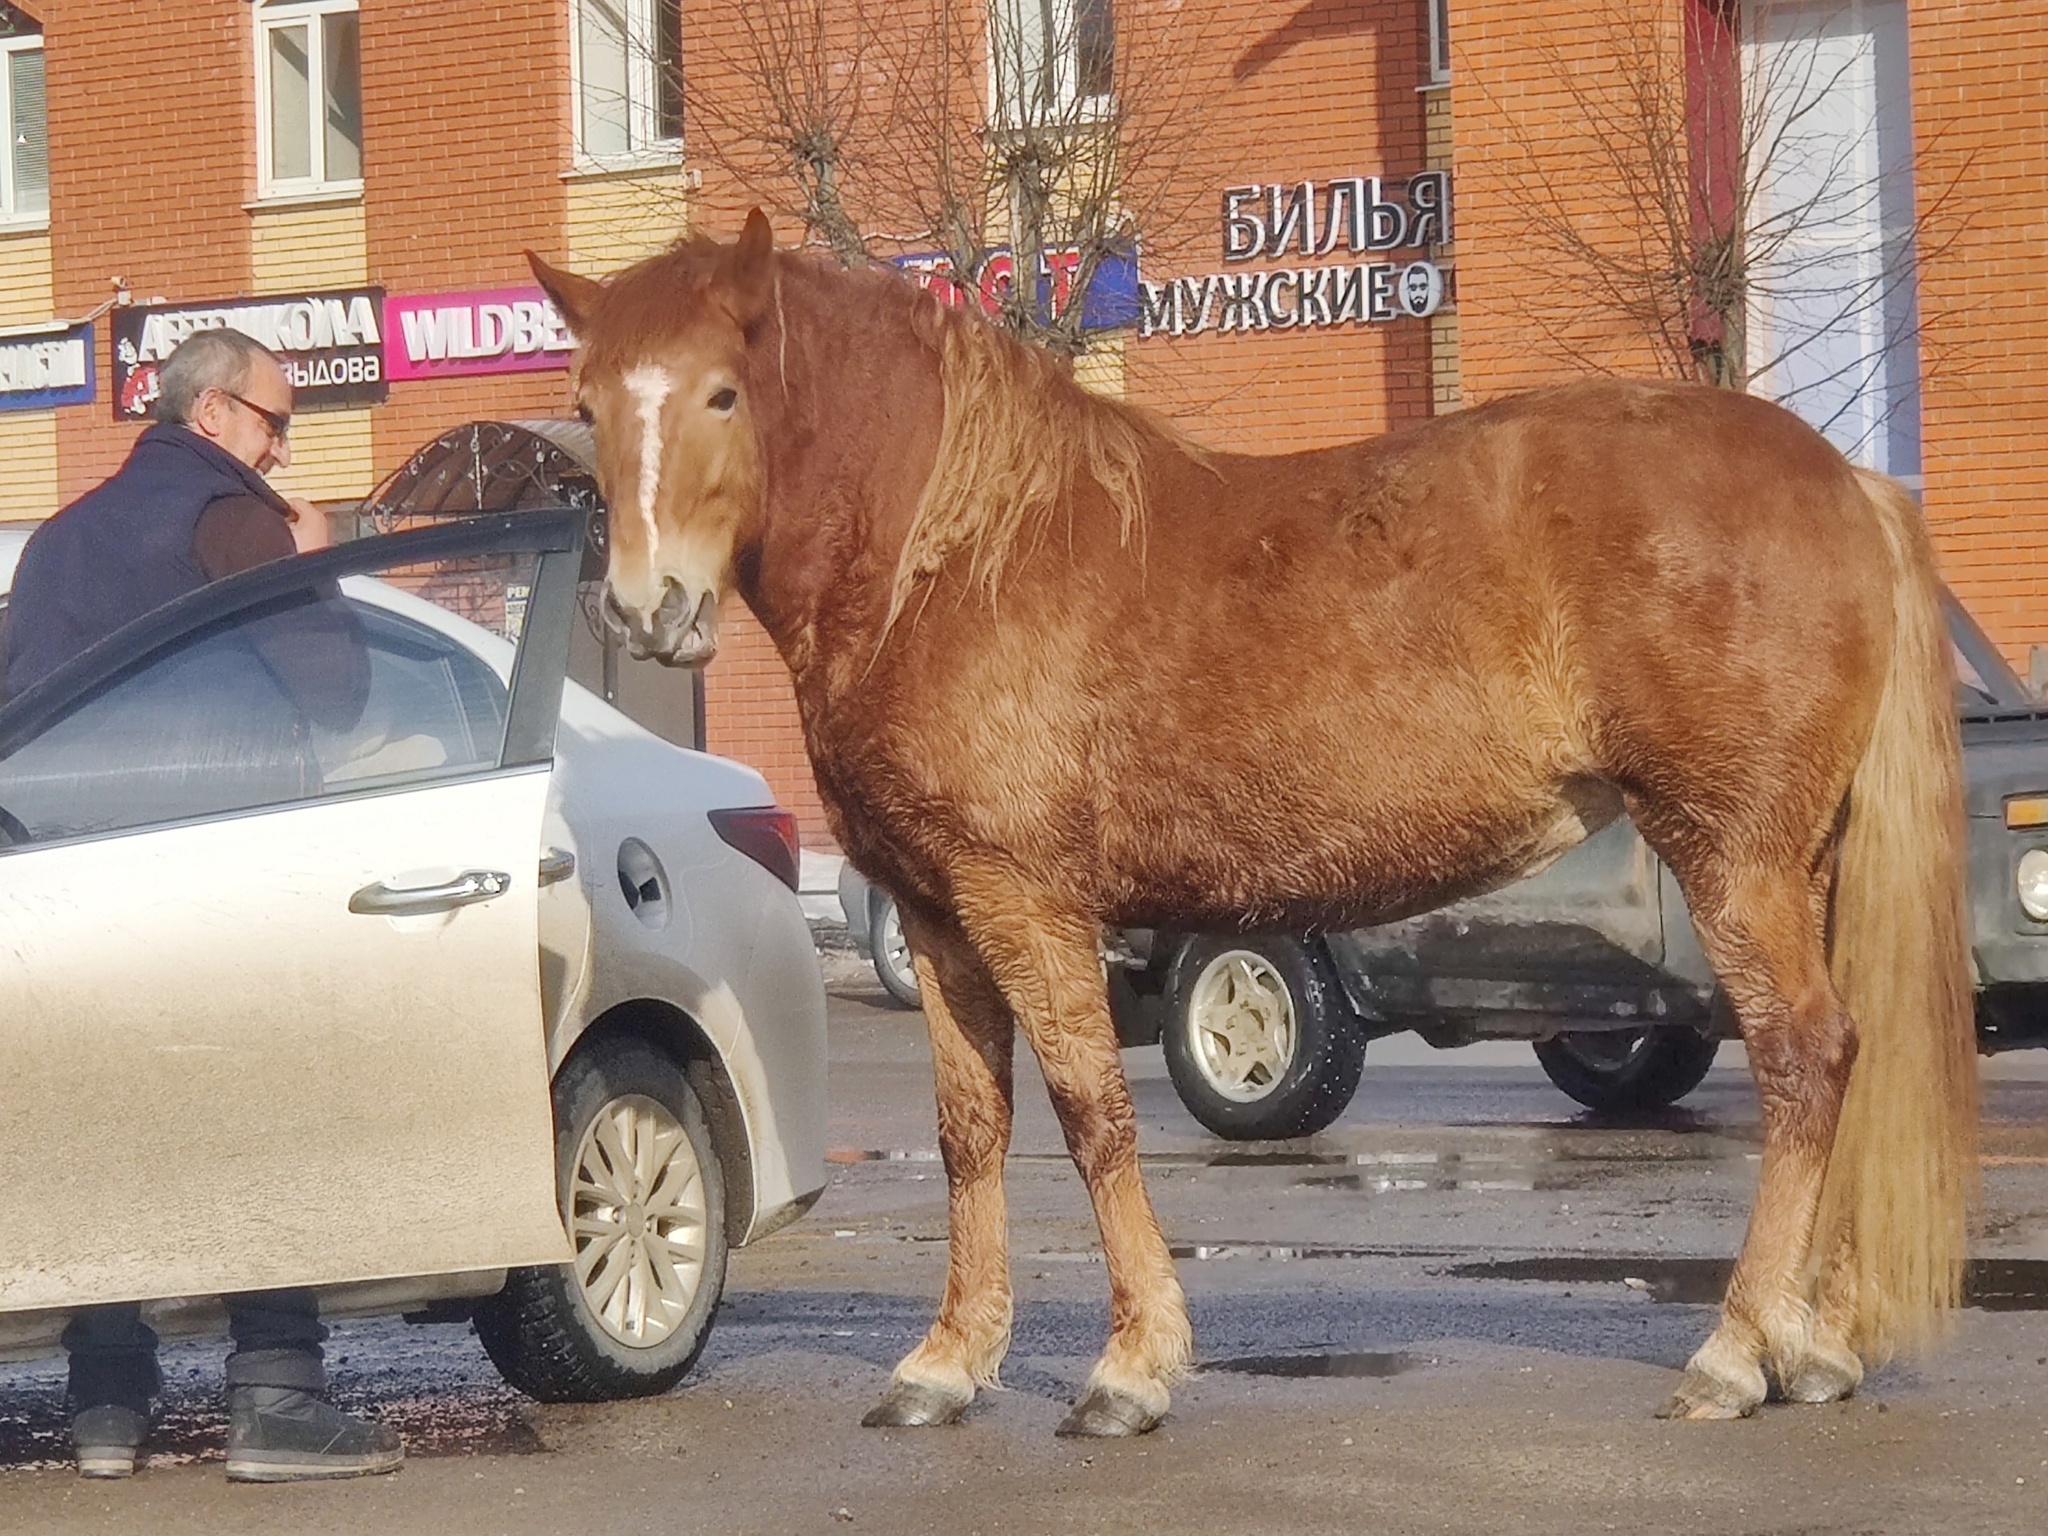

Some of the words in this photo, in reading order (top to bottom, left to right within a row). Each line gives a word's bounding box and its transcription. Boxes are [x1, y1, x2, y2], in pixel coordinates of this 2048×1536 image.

[1223, 170, 1453, 261] БИЛЬЯ
[400, 299, 581, 362] WILDBE
[1138, 262, 1398, 338] МУЖСКИЕ
